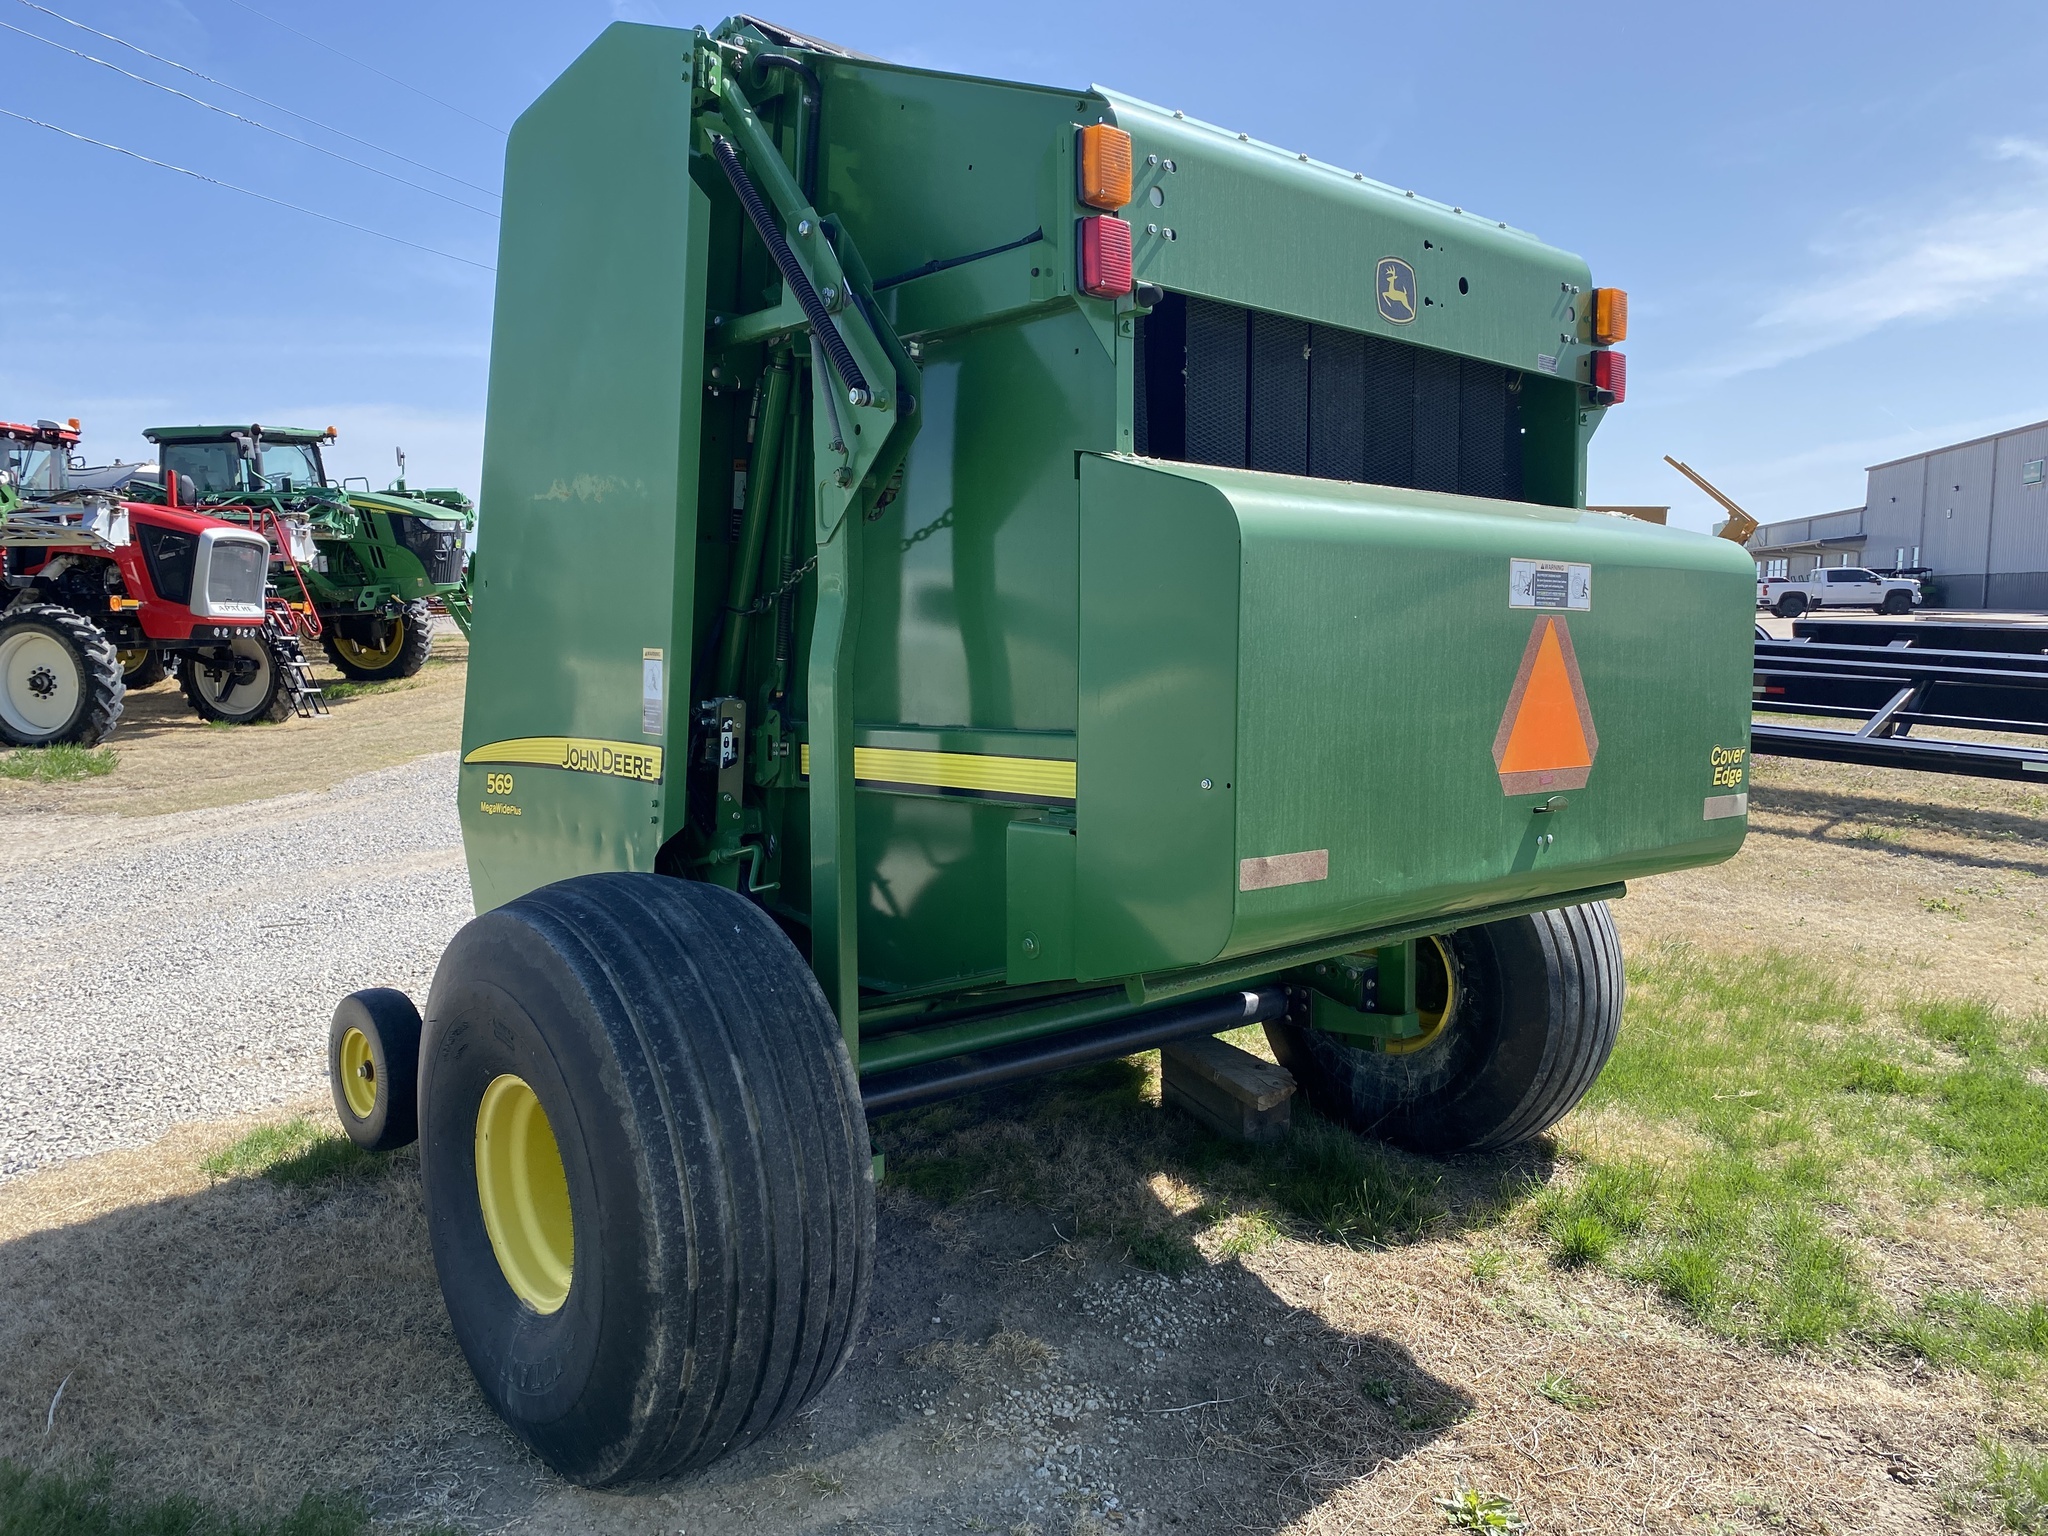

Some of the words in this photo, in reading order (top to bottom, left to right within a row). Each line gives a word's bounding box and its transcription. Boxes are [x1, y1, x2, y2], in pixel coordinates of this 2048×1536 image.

[562, 743, 600, 770] JOHN
[602, 747, 653, 777] DEERE
[1711, 746, 1746, 765] Cover
[487, 773, 513, 795] 569
[1713, 766, 1742, 787] Edge
